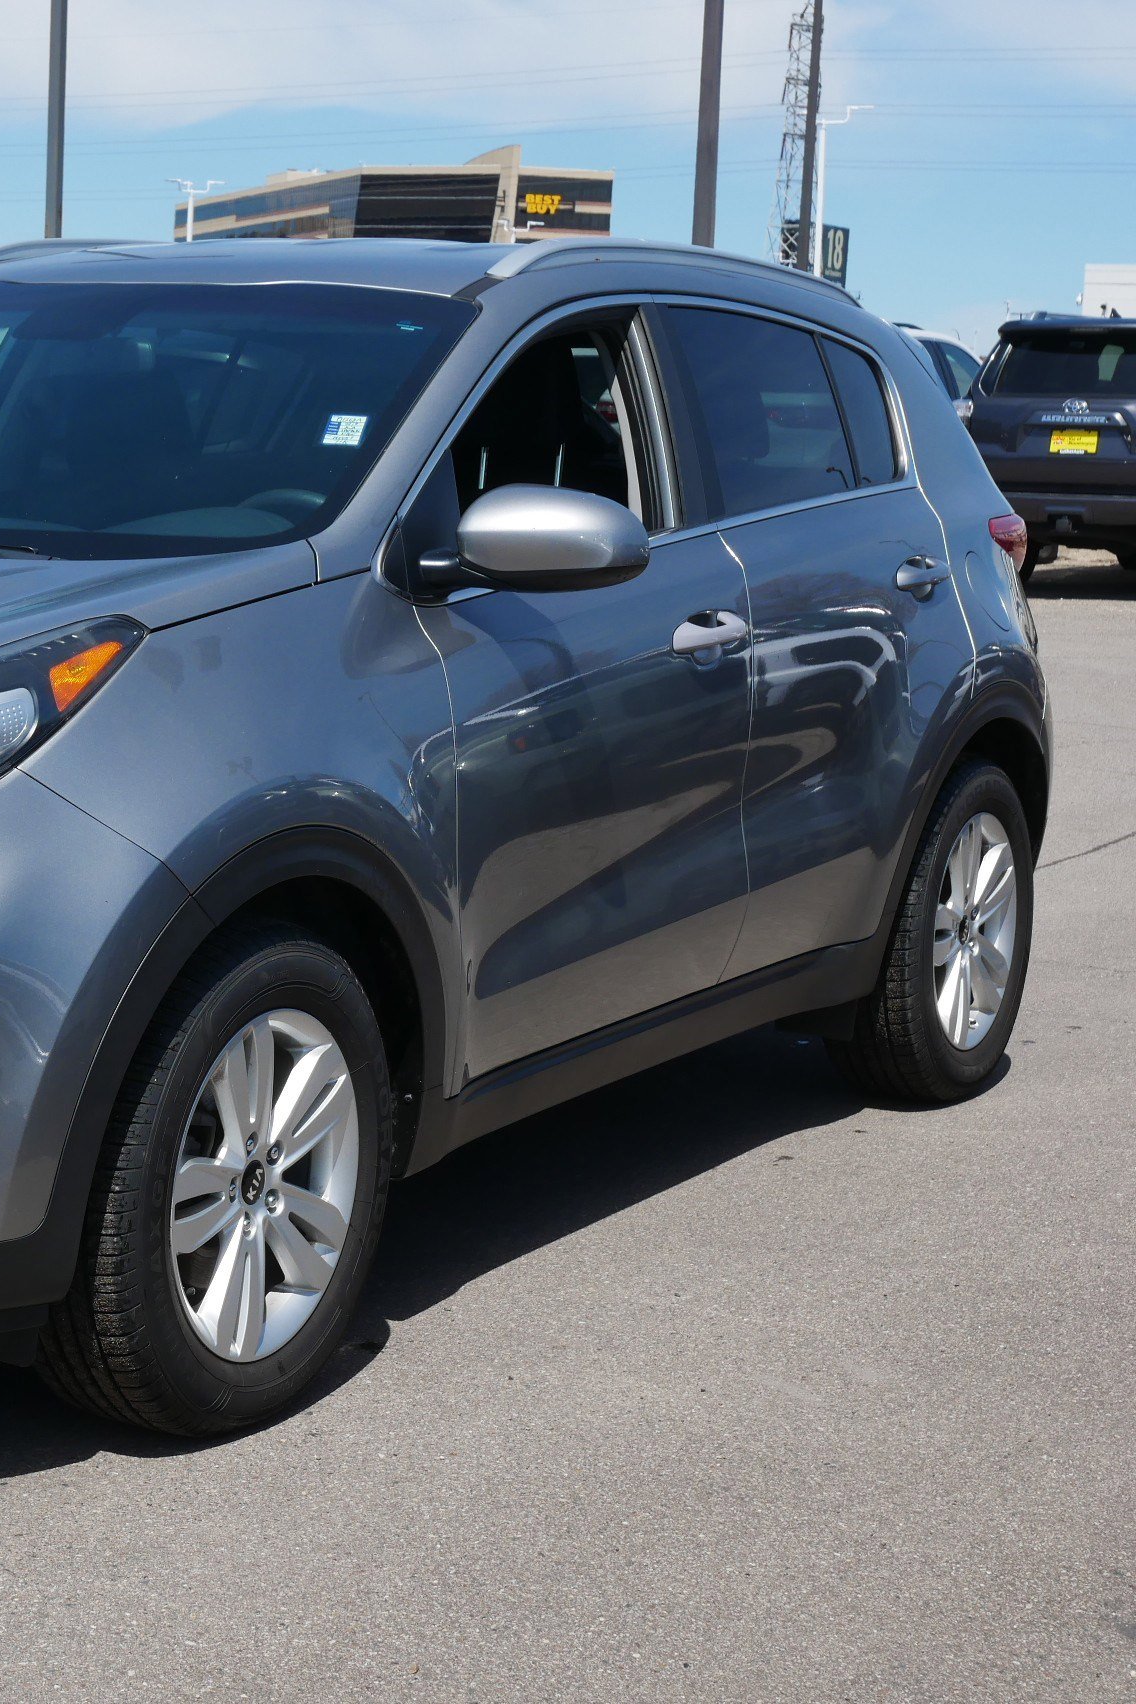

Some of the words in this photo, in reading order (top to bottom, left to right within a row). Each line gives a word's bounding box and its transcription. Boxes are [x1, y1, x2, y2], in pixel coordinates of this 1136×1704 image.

[525, 193, 562, 205] BEST
[526, 203, 559, 215] BUY
[827, 228, 845, 270] 18
[246, 1168, 264, 1201] KIA
